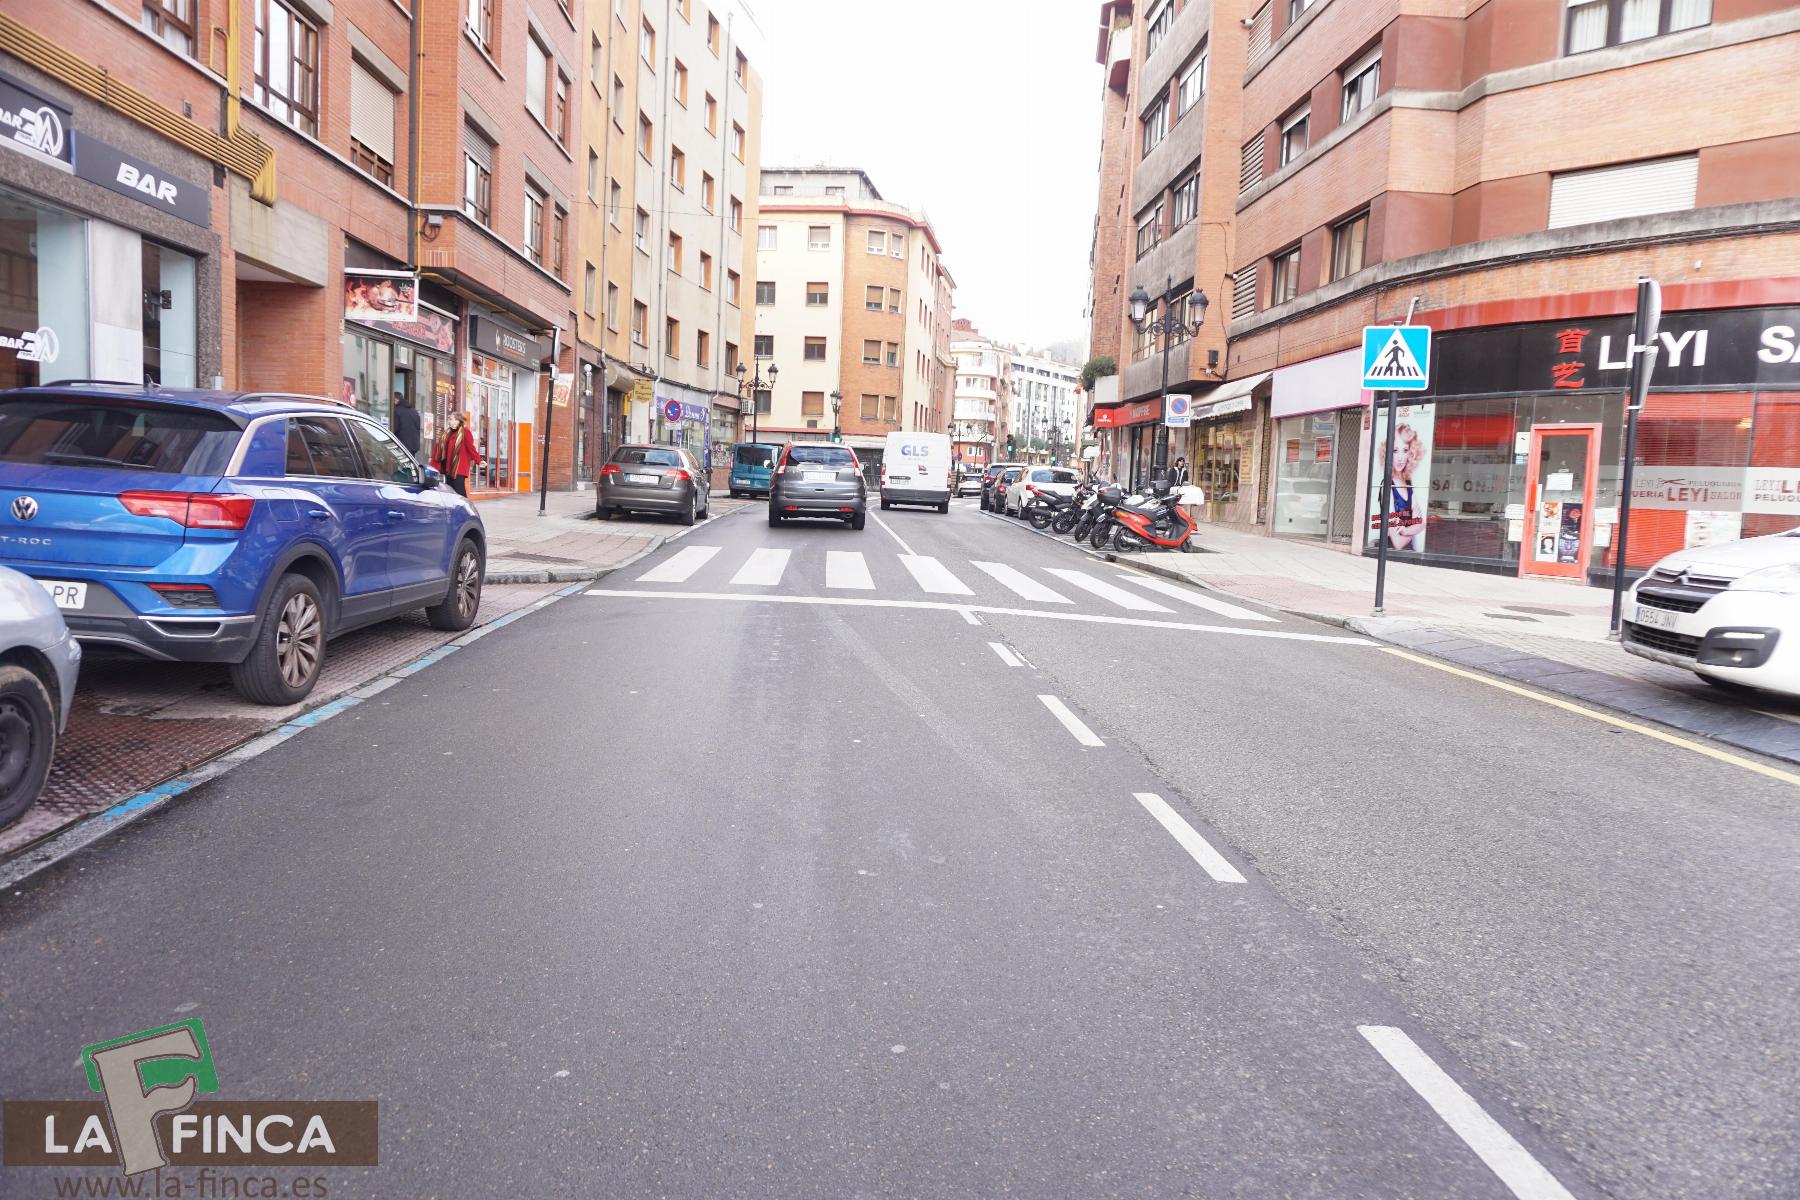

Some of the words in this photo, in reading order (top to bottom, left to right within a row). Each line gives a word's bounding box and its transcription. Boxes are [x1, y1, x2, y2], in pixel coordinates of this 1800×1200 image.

[116, 162, 178, 206] BAR
[901, 445, 929, 457] GLS
[1667, 487, 1709, 502] LEYI
[1, 535, 52, 546] T-ROC
